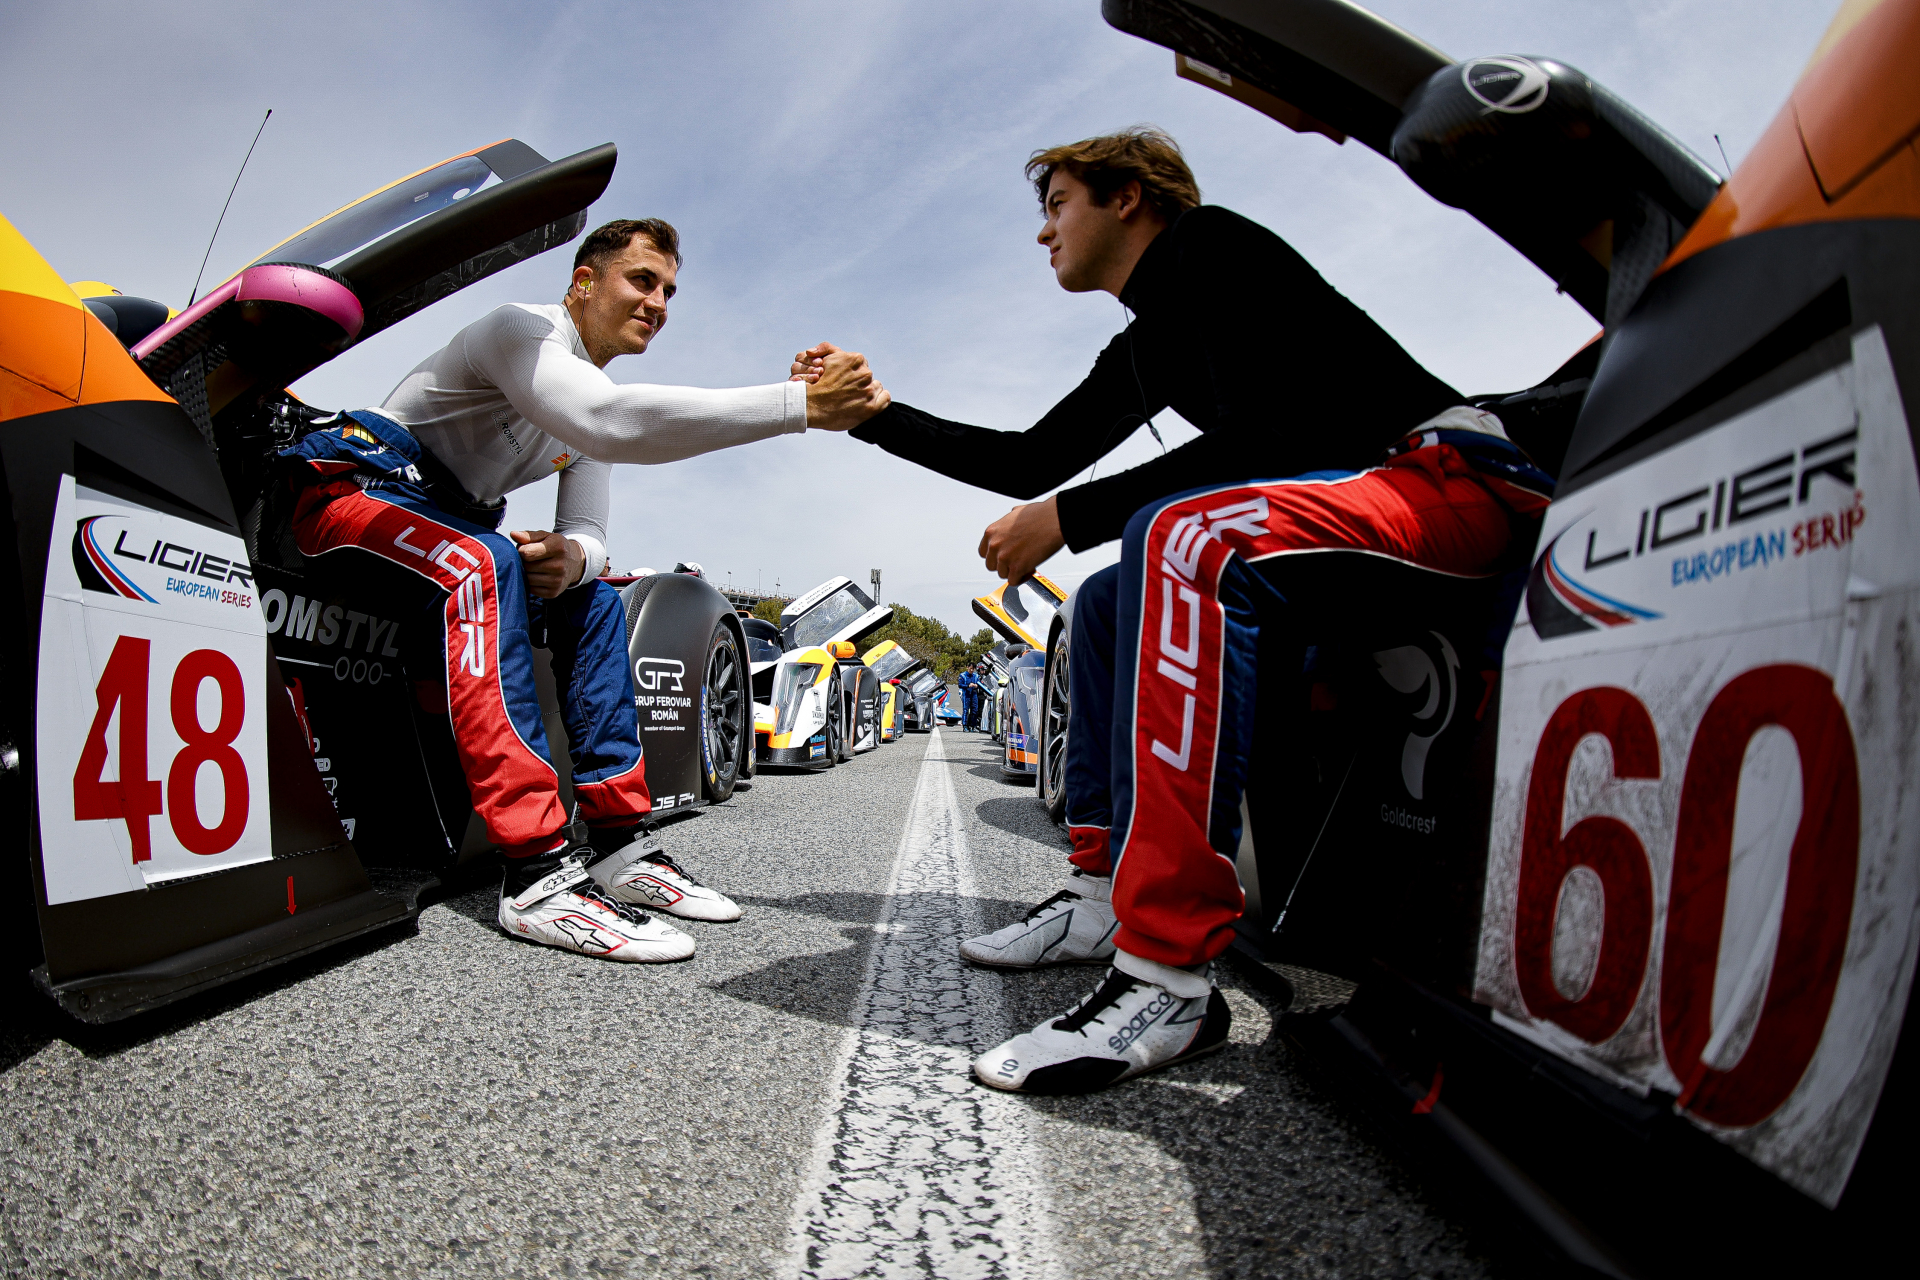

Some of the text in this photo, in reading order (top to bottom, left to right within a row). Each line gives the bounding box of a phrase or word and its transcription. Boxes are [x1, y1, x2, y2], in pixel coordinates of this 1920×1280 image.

[501, 422, 524, 455] ROMSTYL
[1584, 427, 1858, 572] LIGIER
[114, 530, 253, 589] LIGIER
[1671, 527, 1787, 588] EUROPEAN
[166, 577, 252, 609] EUROPEAN SERIES
[261, 588, 399, 658] OMSTYL
[394, 526, 486, 678] LIGIER
[1151, 496, 1271, 772] LIGIER
[635, 656, 686, 691] GFR
[635, 695, 692, 708] GRUP FEROVIAR
[651, 707, 679, 721] ROMÂN
[73, 634, 250, 865] 48
[651, 792, 695, 811] JS P4
[1380, 803, 1437, 834] Goldcrest
[1514, 661, 1862, 1129] 60
[1108, 992, 1175, 1055] sparco
